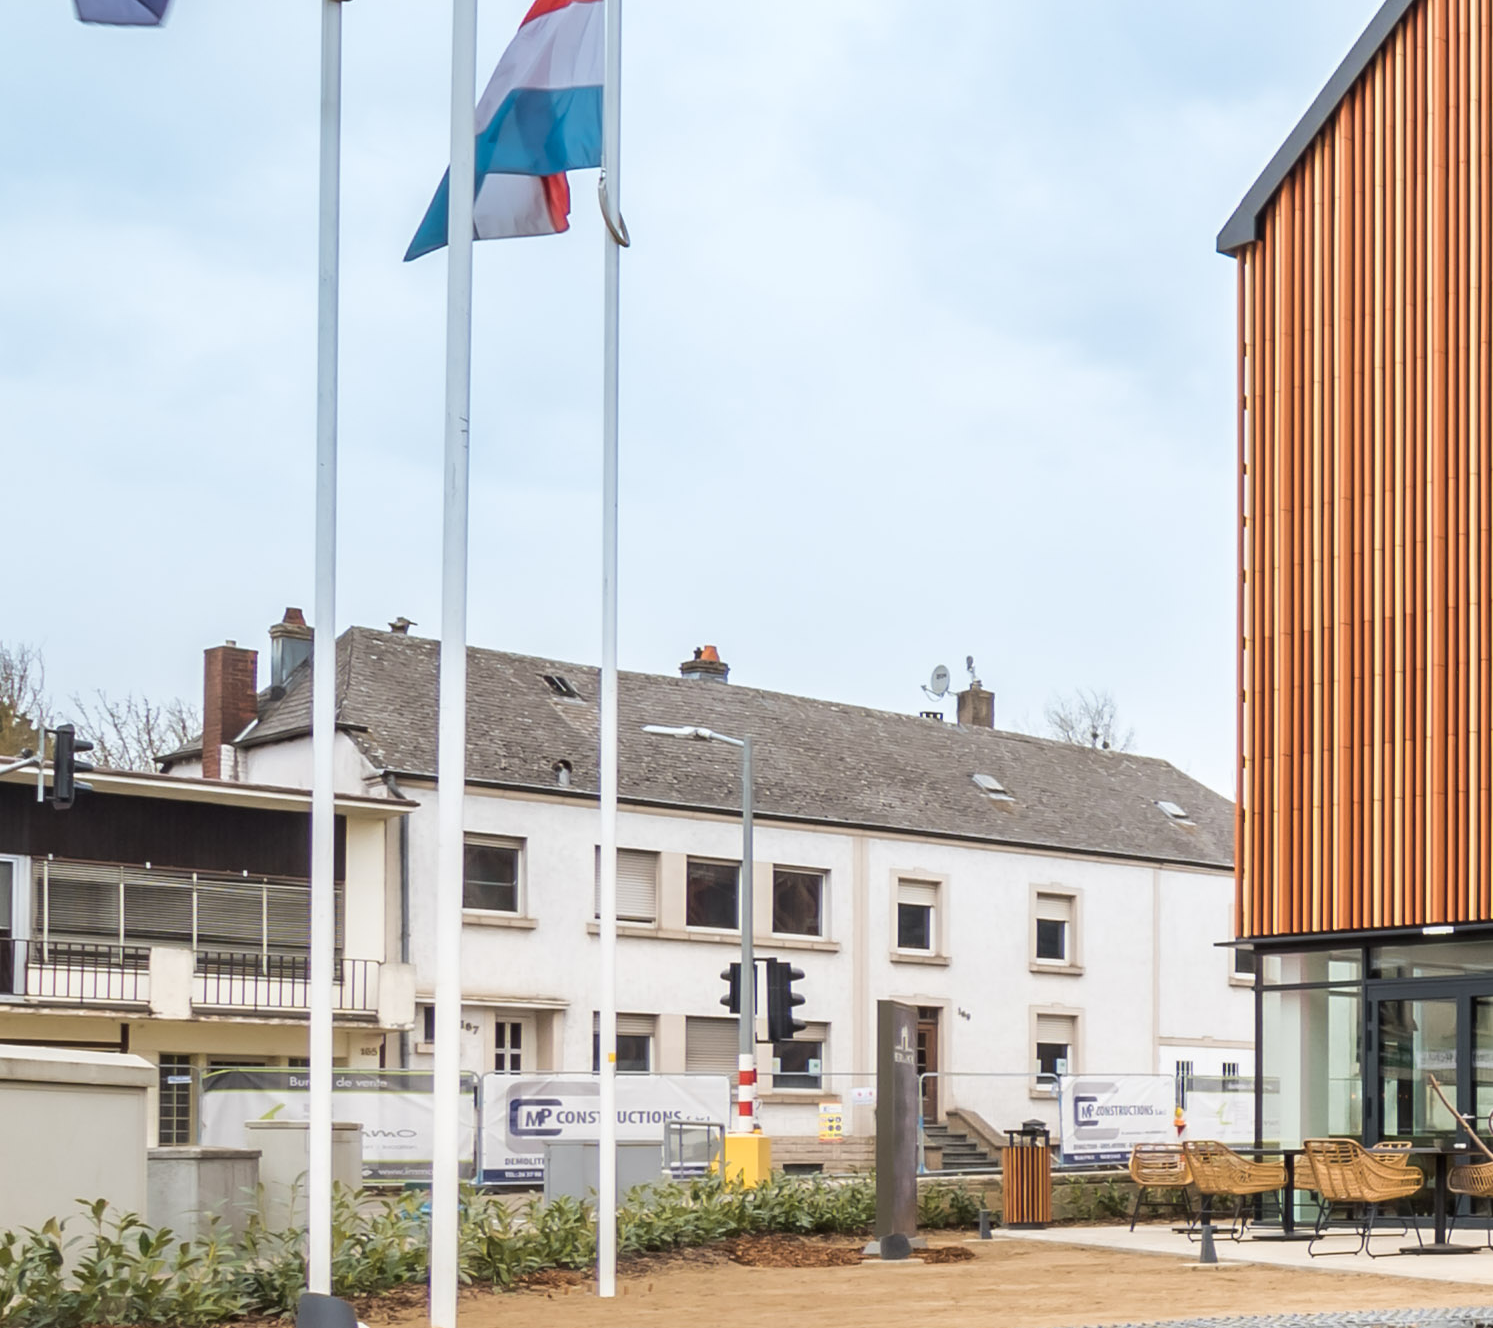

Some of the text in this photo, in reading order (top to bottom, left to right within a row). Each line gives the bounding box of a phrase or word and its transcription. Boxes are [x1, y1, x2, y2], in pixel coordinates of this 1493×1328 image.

[336, 1077, 353, 1087] de
[355, 1079, 388, 1088] vente
[556, 1110, 682, 1124] CONSTUCTIONS
